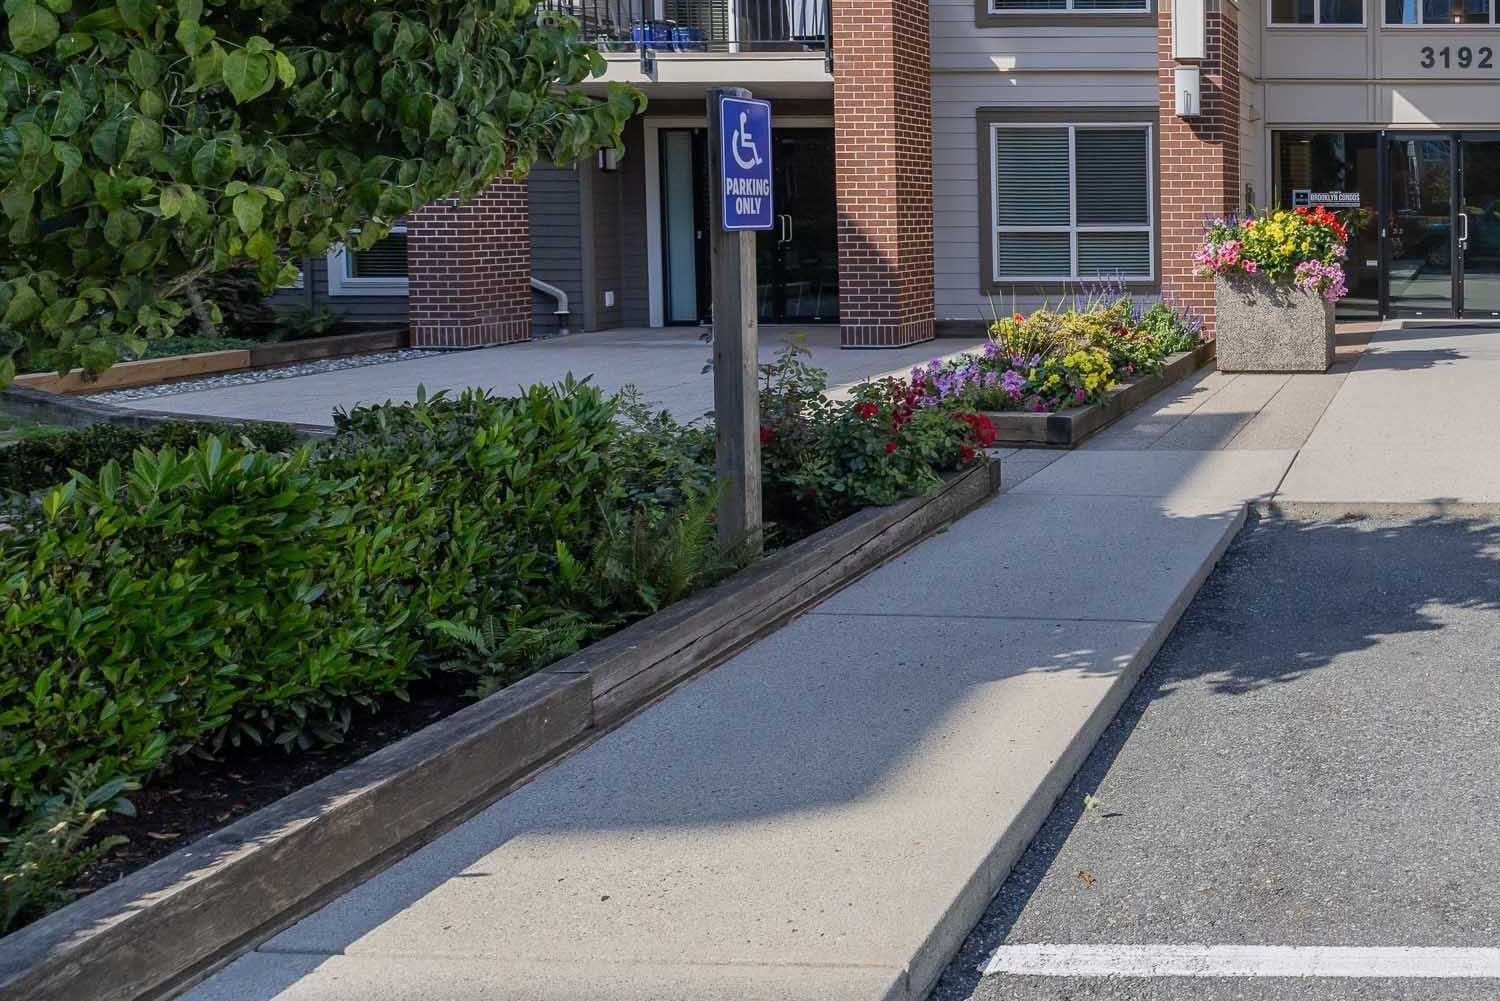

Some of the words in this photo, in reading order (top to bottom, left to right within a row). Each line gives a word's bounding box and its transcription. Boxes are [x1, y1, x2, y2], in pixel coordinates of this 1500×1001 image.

[1420, 46, 1493, 69] 3192
[726, 177, 769, 196] PARKING
[736, 196, 761, 215] ONLY
[1310, 192, 1338, 201] BROOKLYN
